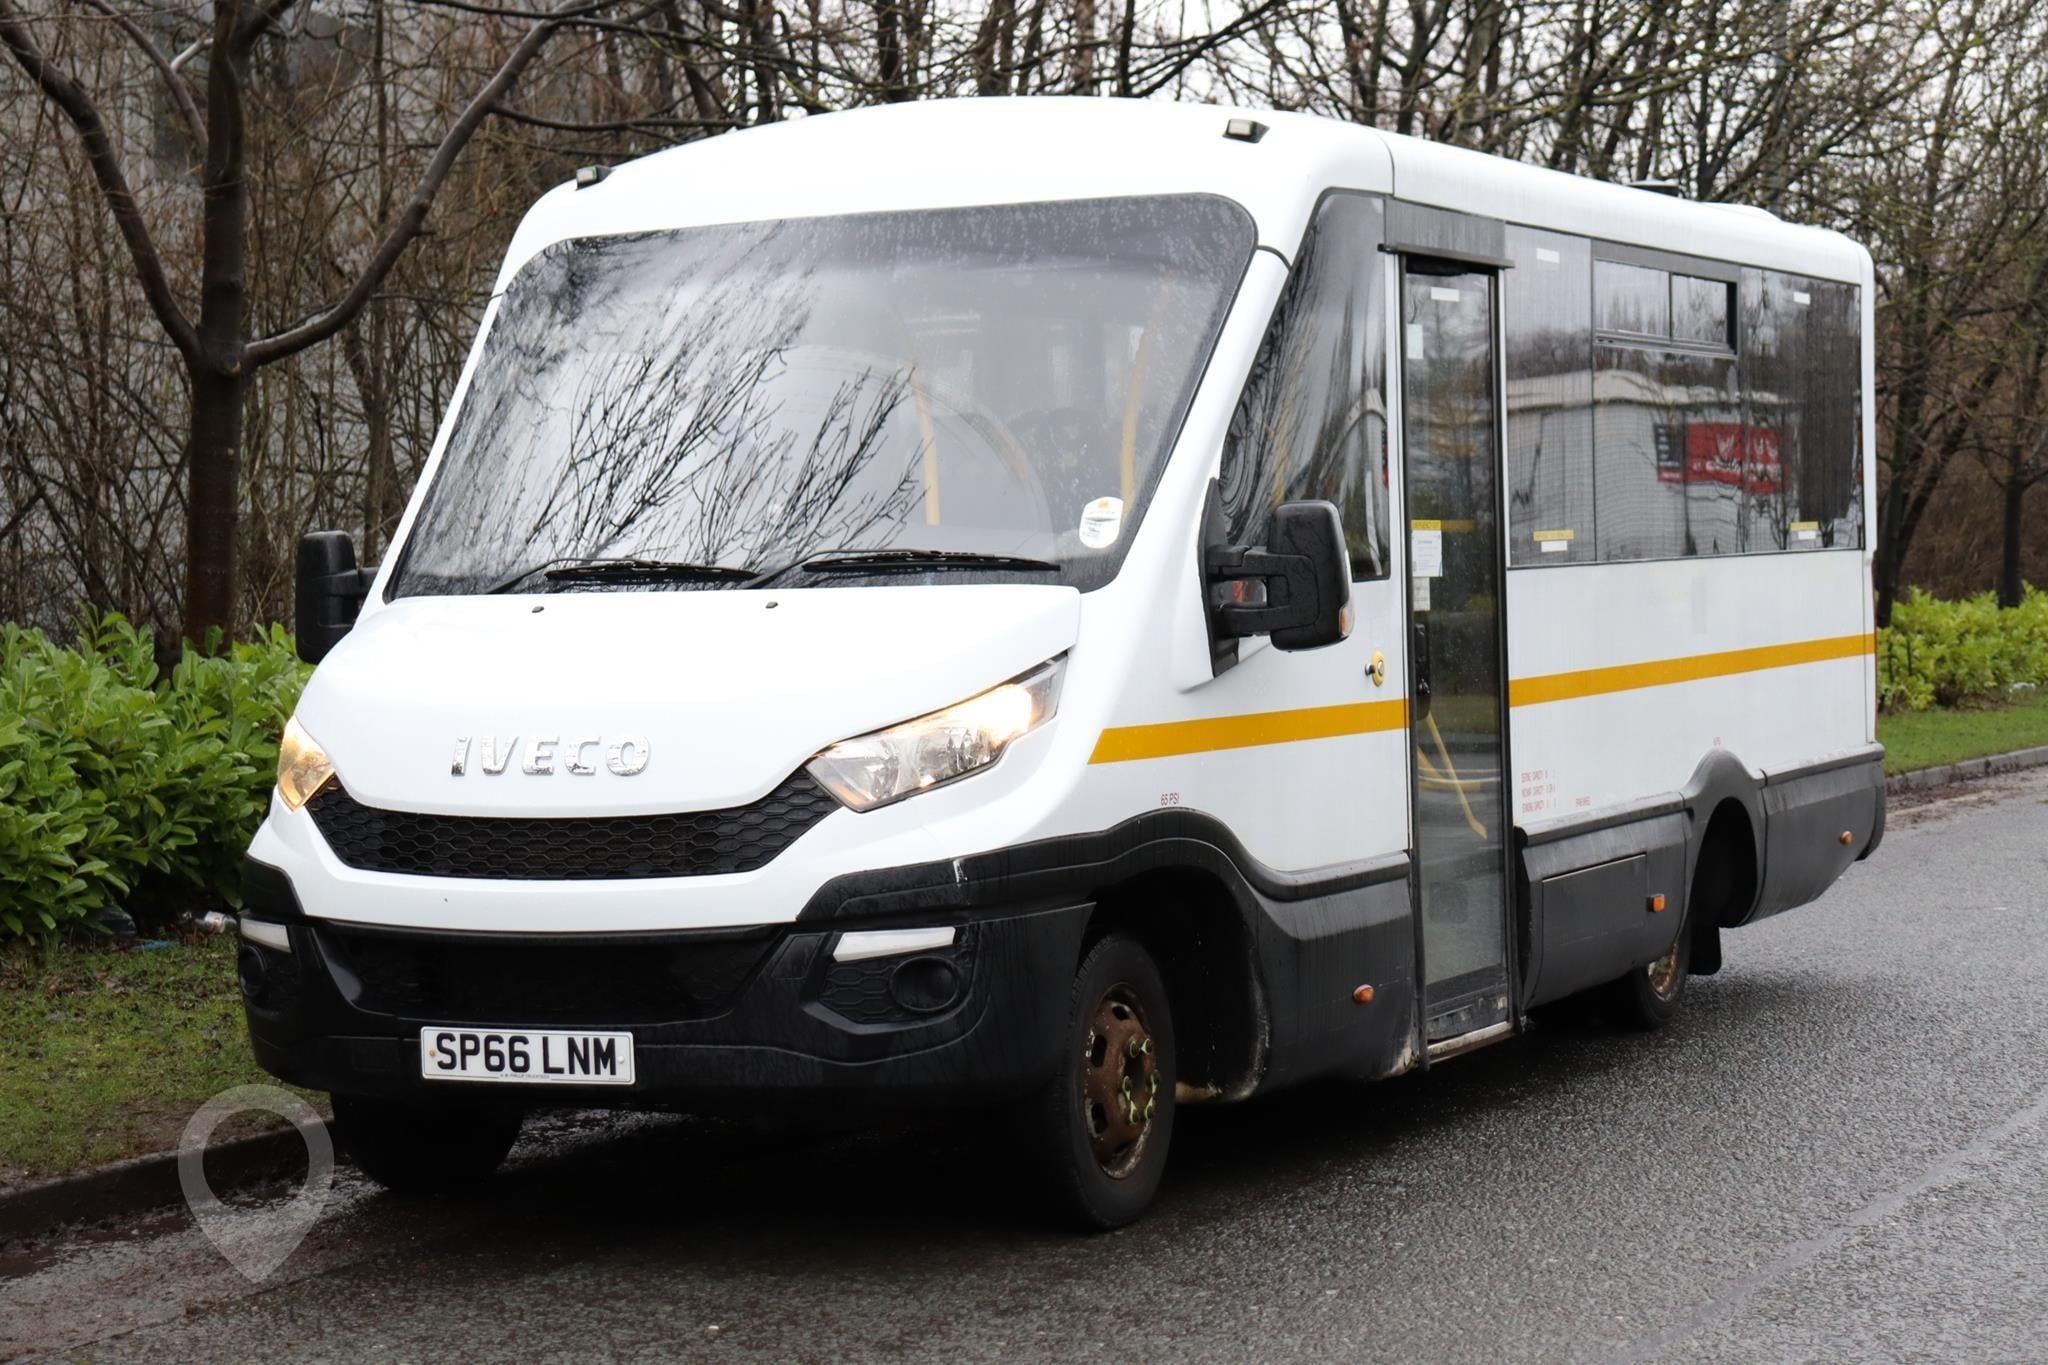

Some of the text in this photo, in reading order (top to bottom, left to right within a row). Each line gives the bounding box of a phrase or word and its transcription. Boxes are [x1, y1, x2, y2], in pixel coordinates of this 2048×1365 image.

[451, 735, 651, 776] IVECO
[1160, 792, 1180, 806] 65 PSI
[436, 1032, 617, 1075] SP66 LNM
